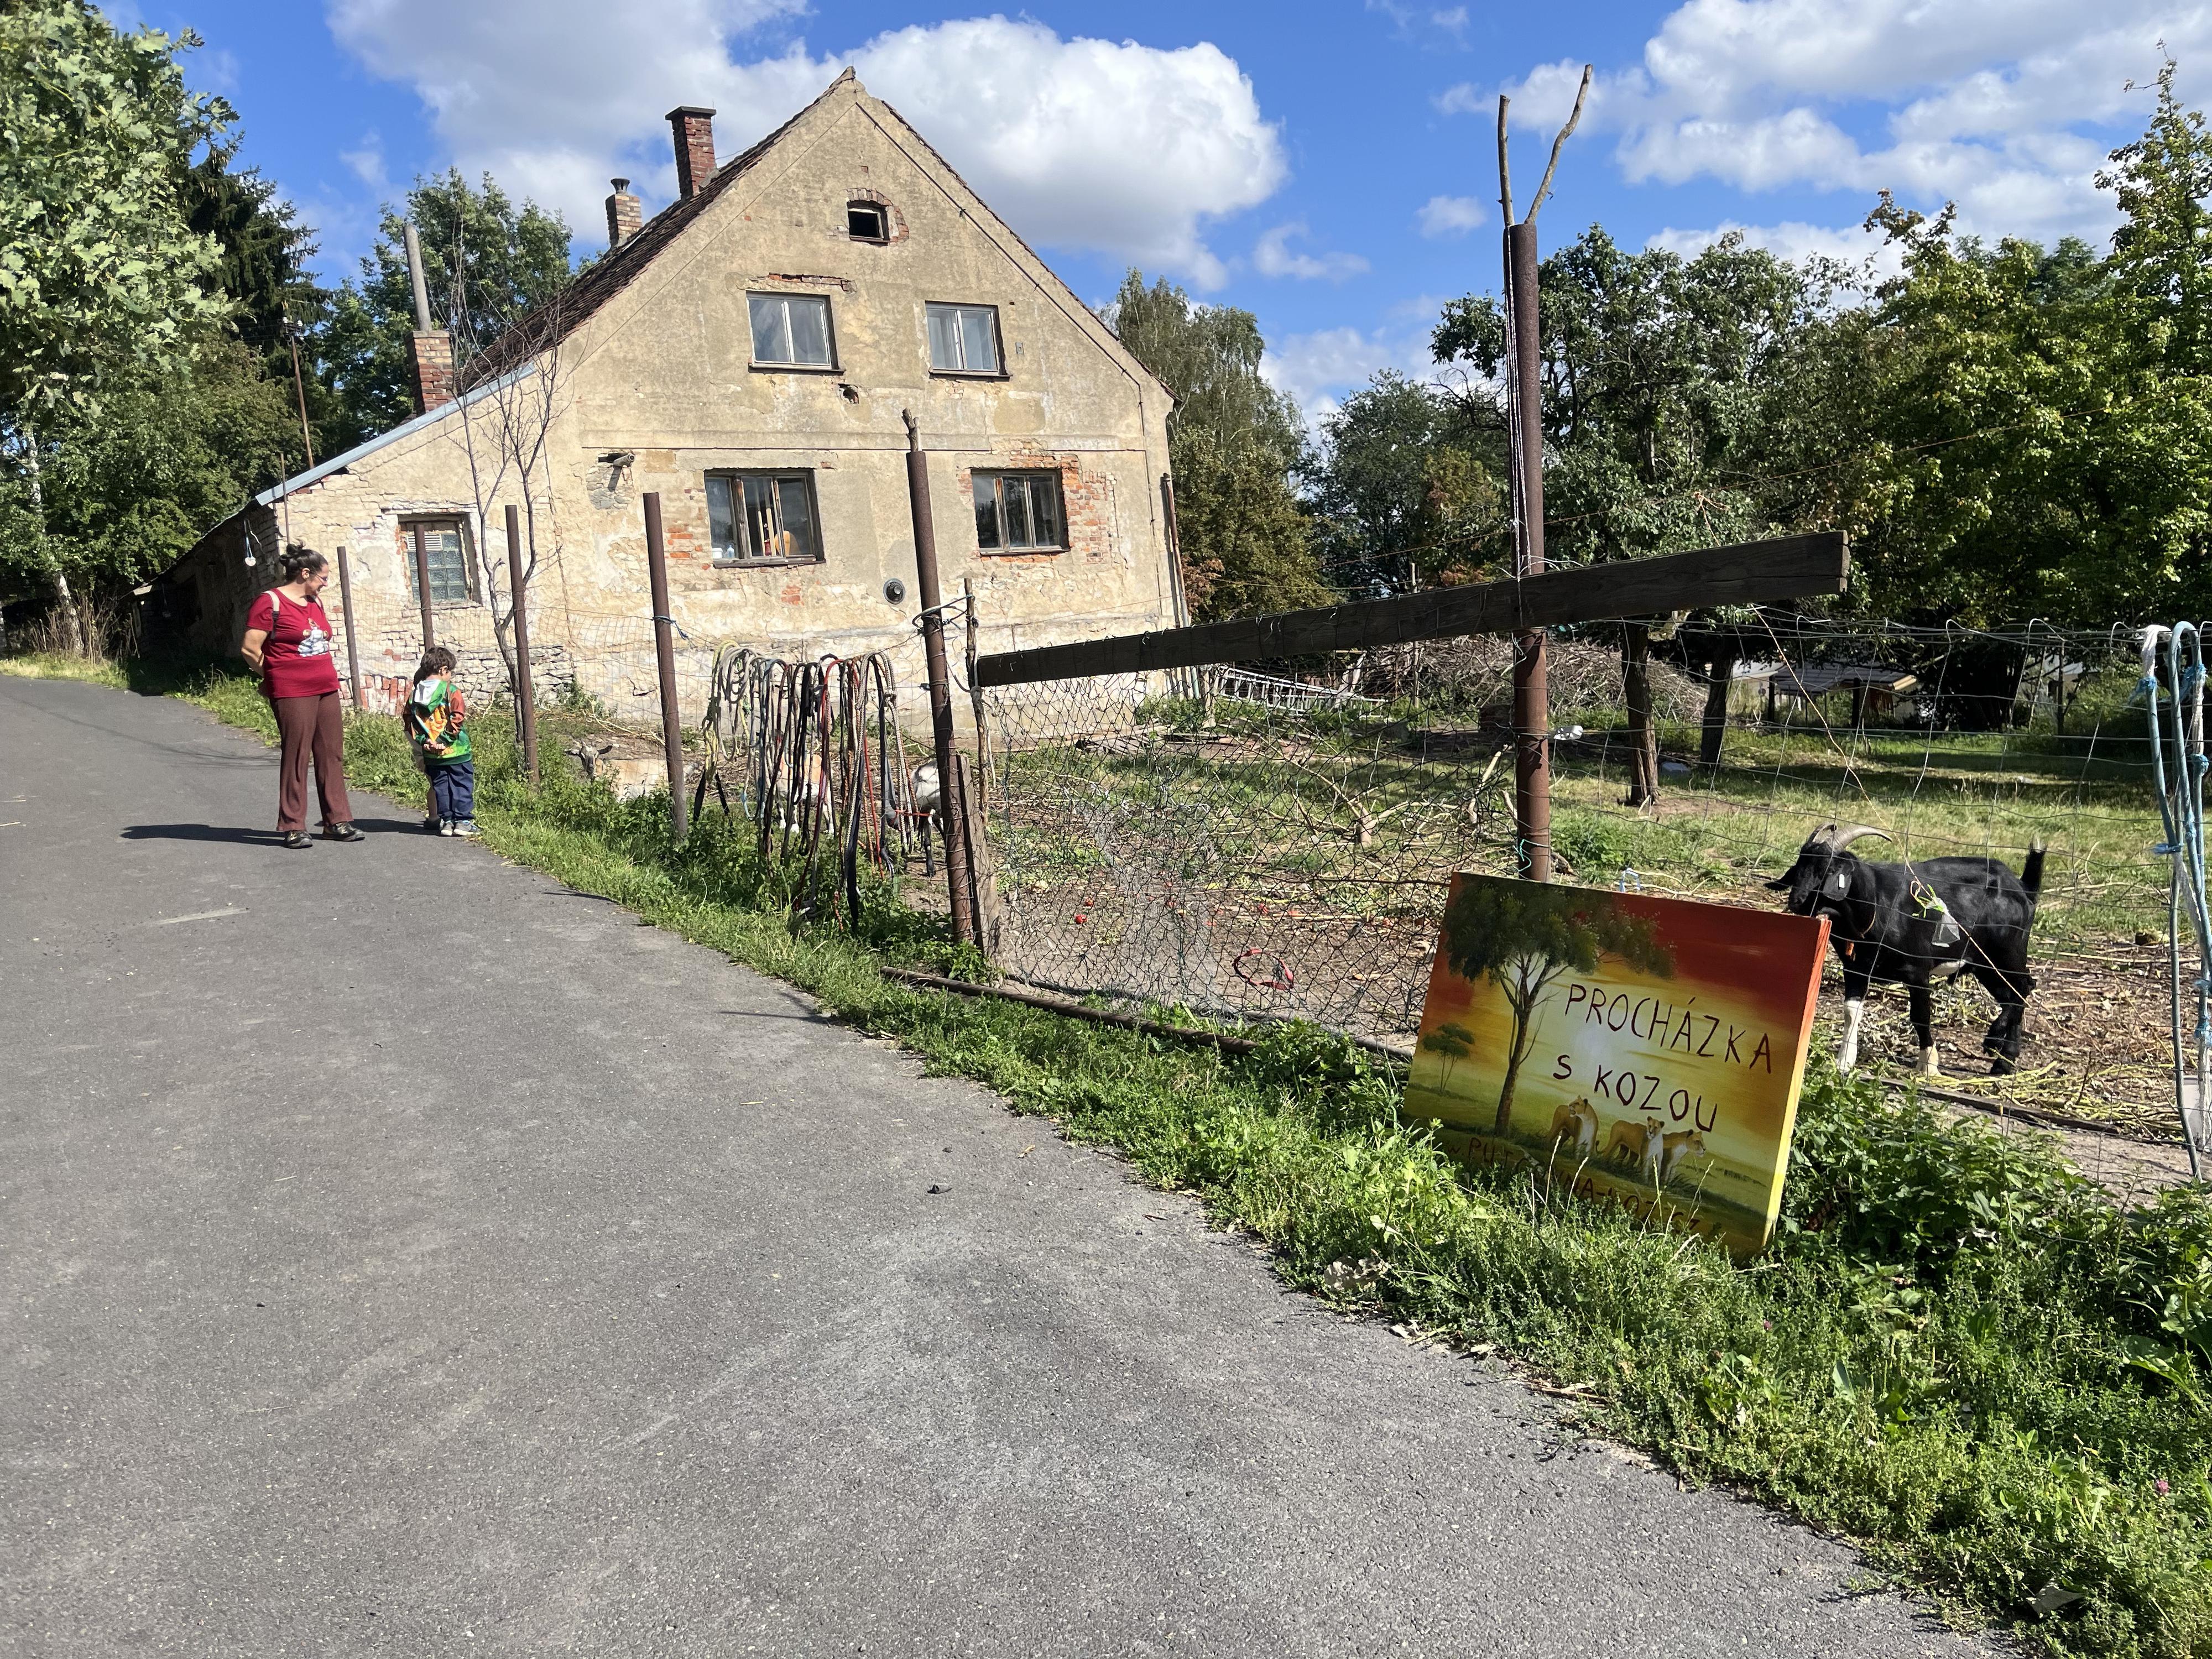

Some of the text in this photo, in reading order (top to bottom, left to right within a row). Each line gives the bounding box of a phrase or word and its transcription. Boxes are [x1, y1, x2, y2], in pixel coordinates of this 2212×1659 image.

[1564, 983, 1772, 1074] PROCHÁZKA
[1553, 1054, 1718, 1133] S KOZOU
